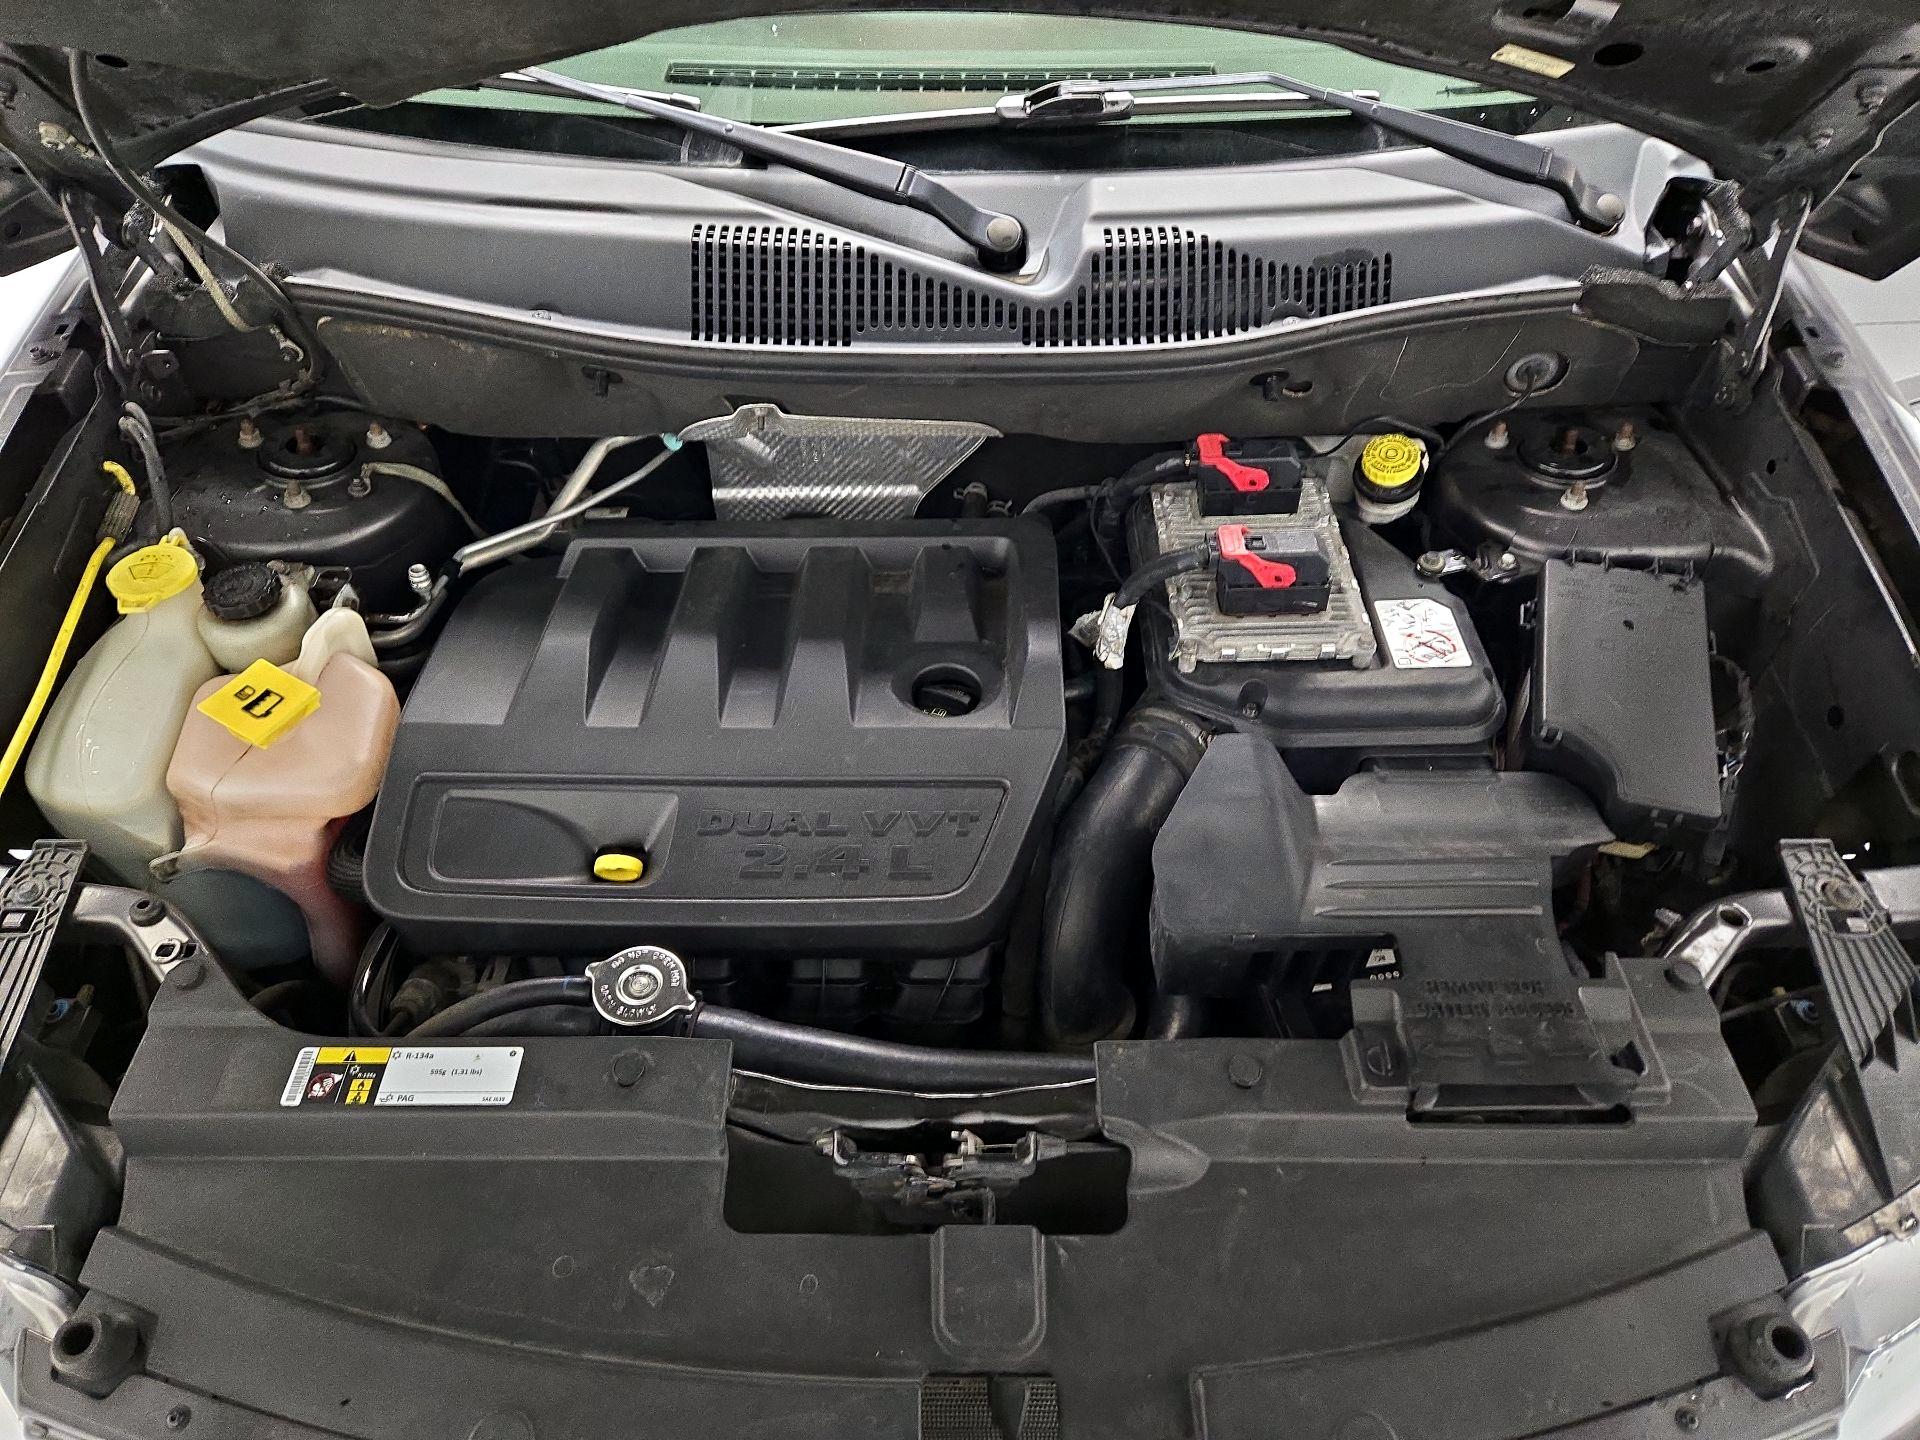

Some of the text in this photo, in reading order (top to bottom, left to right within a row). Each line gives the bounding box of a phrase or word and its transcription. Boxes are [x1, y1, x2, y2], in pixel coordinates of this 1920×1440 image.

[697, 808, 980, 837] DUAL VVT
[405, 1052, 434, 1060] R-134a
[451, 1068, 468, 1076] (1.31
[469, 1068, 483, 1076] lbs)
[396, 1094, 415, 1102] PAG
